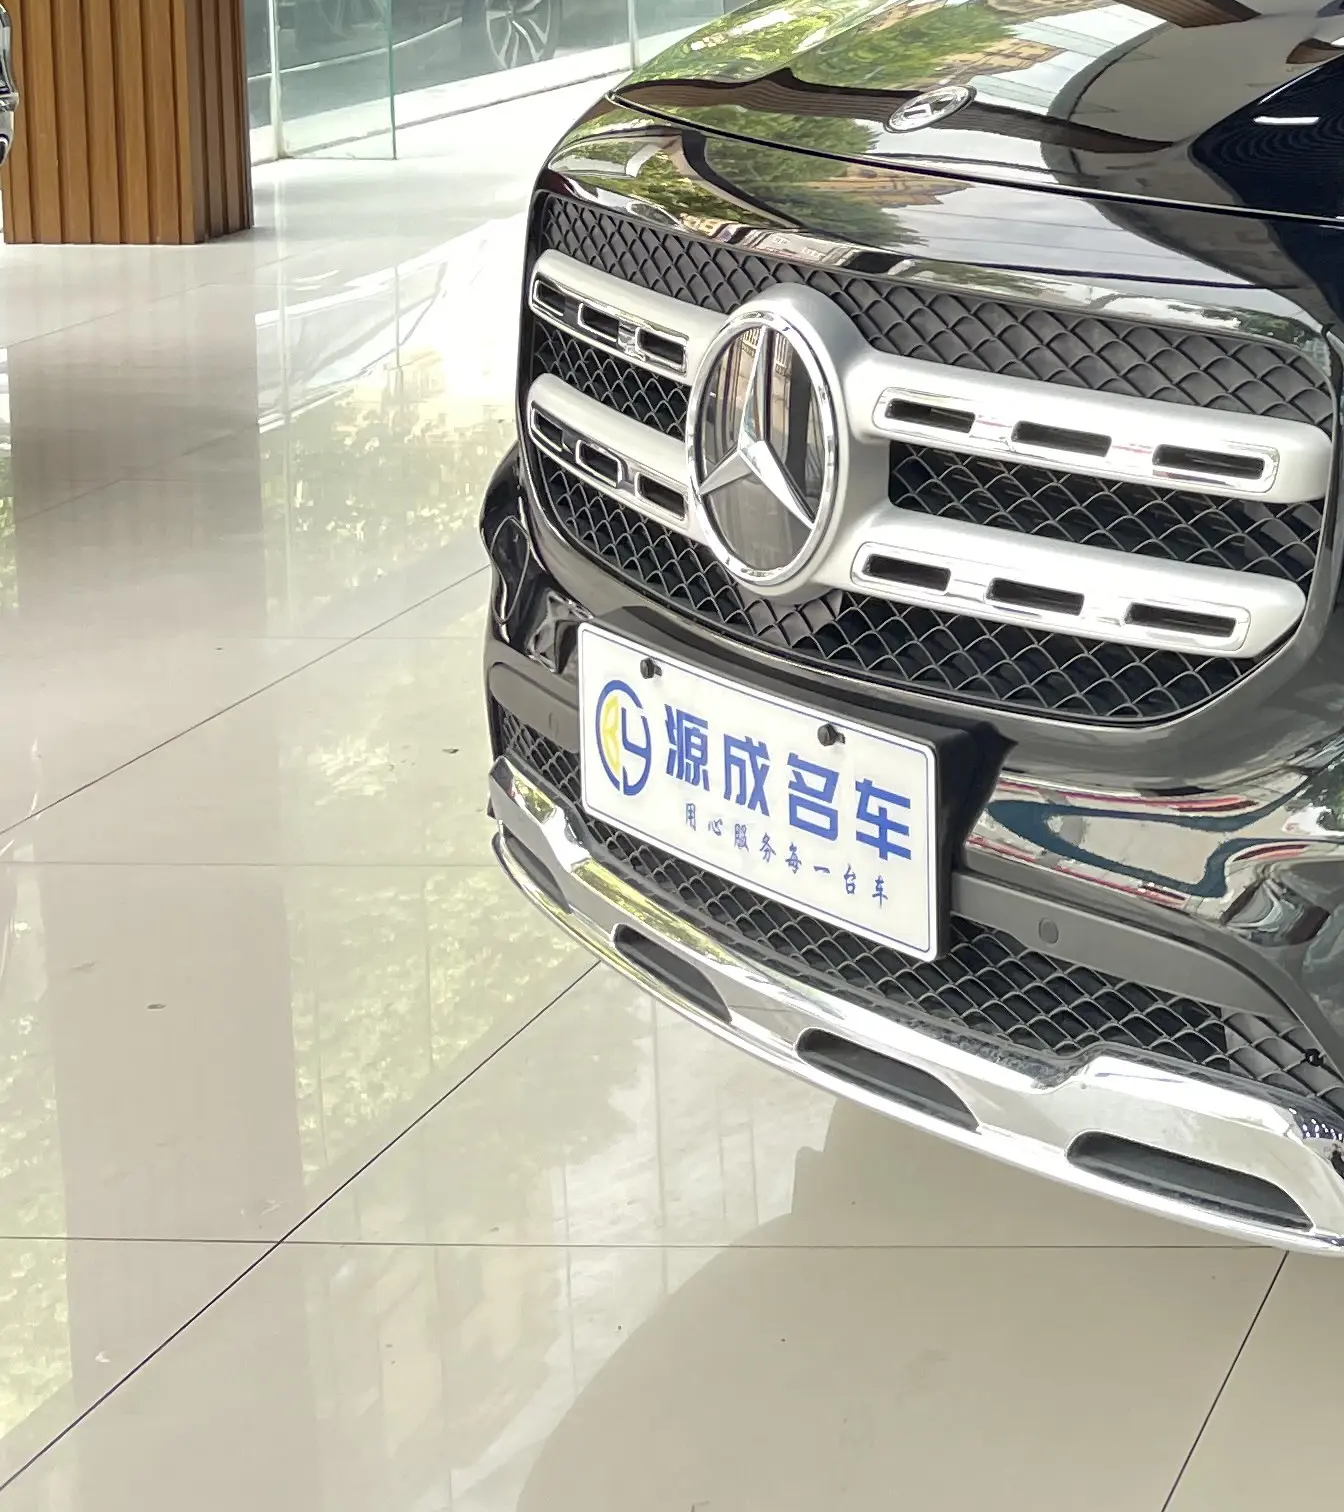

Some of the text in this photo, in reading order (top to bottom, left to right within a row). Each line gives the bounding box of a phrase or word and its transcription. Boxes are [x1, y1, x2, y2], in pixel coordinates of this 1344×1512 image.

[664, 703, 912, 861] 源成名车
[684, 801, 889, 908] 用心服务每一台车
